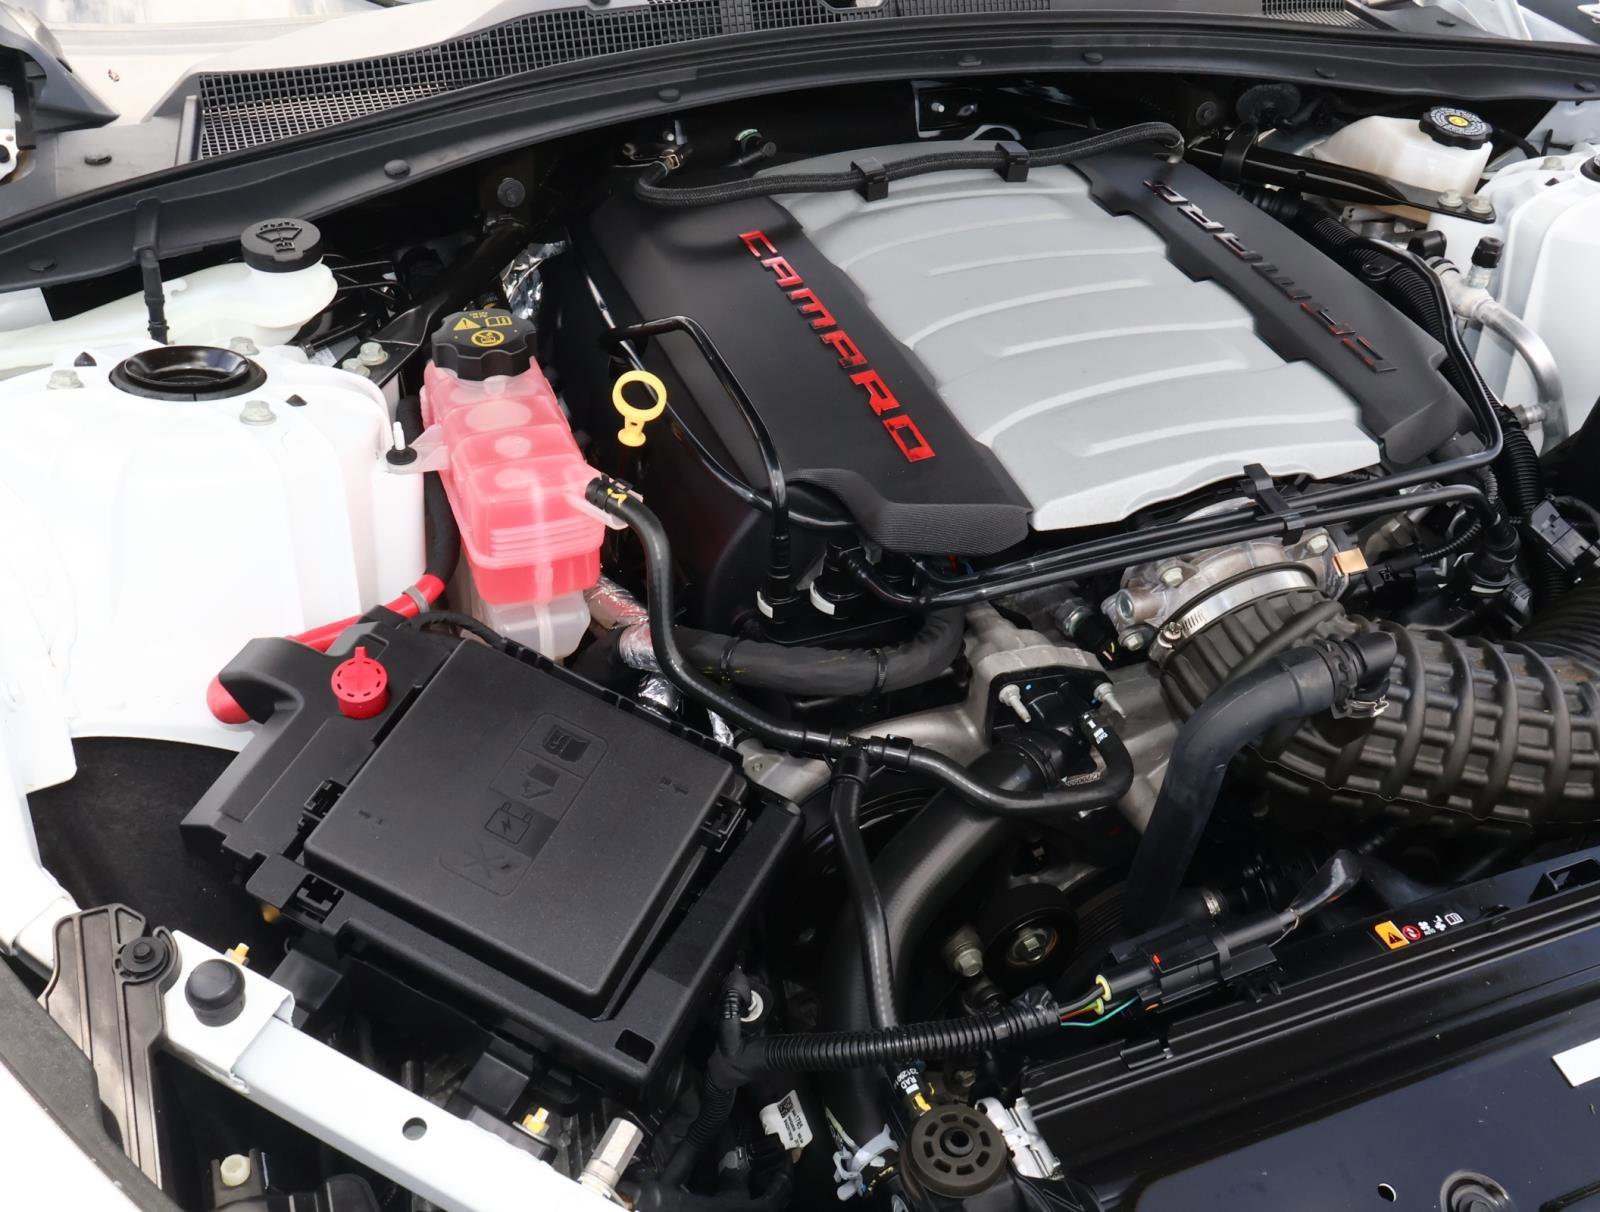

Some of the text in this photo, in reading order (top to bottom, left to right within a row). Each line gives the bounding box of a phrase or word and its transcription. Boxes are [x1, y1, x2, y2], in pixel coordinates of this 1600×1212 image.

[738, 230, 935, 463] CAMARO
[1143, 179, 1397, 372] CAMARO
[901, 1076, 917, 1089] RAD
